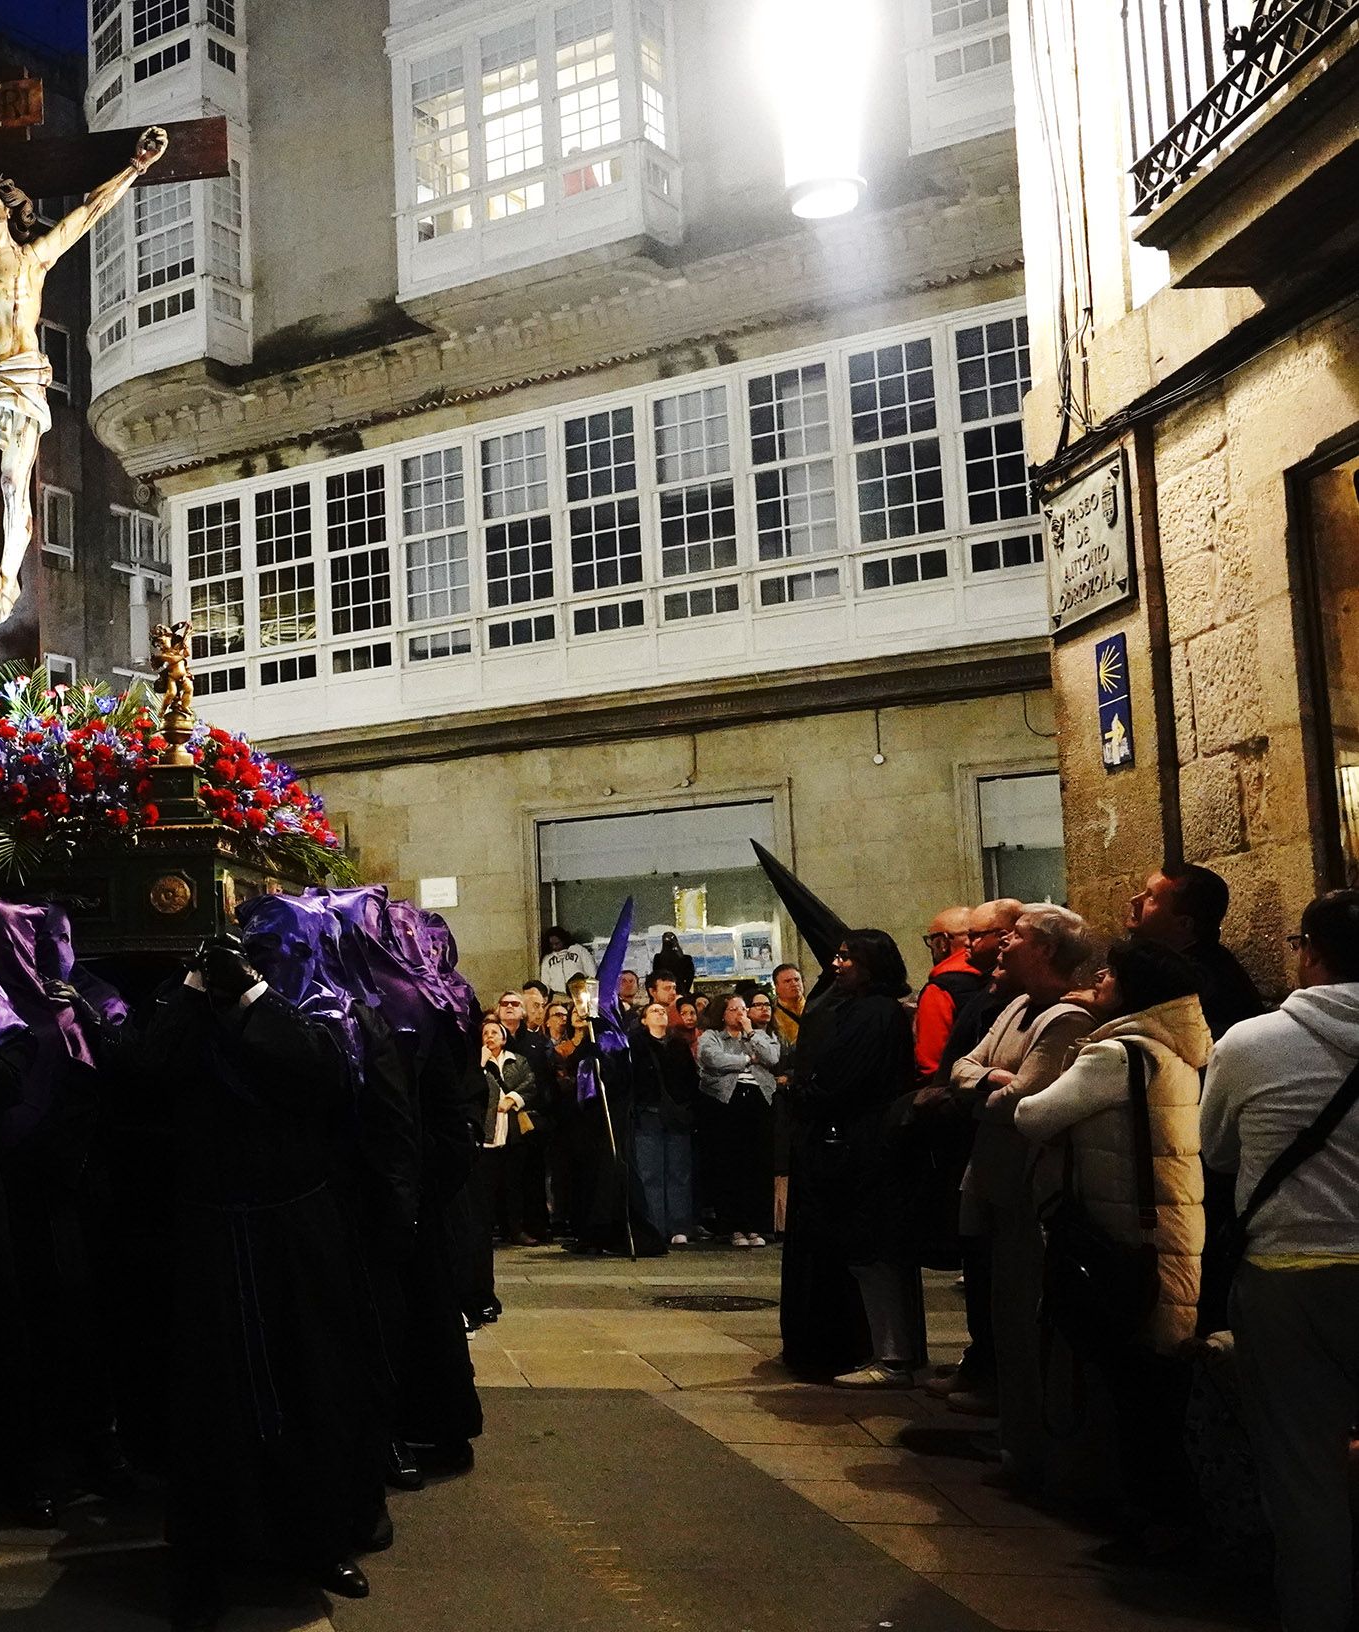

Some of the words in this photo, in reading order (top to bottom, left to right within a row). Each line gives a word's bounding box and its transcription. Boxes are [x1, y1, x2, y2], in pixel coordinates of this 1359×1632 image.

[1067, 493, 1099, 526] PASEO
[1076, 526, 1091, 549] DE
[1064, 543, 1110, 583] ANTONIO
